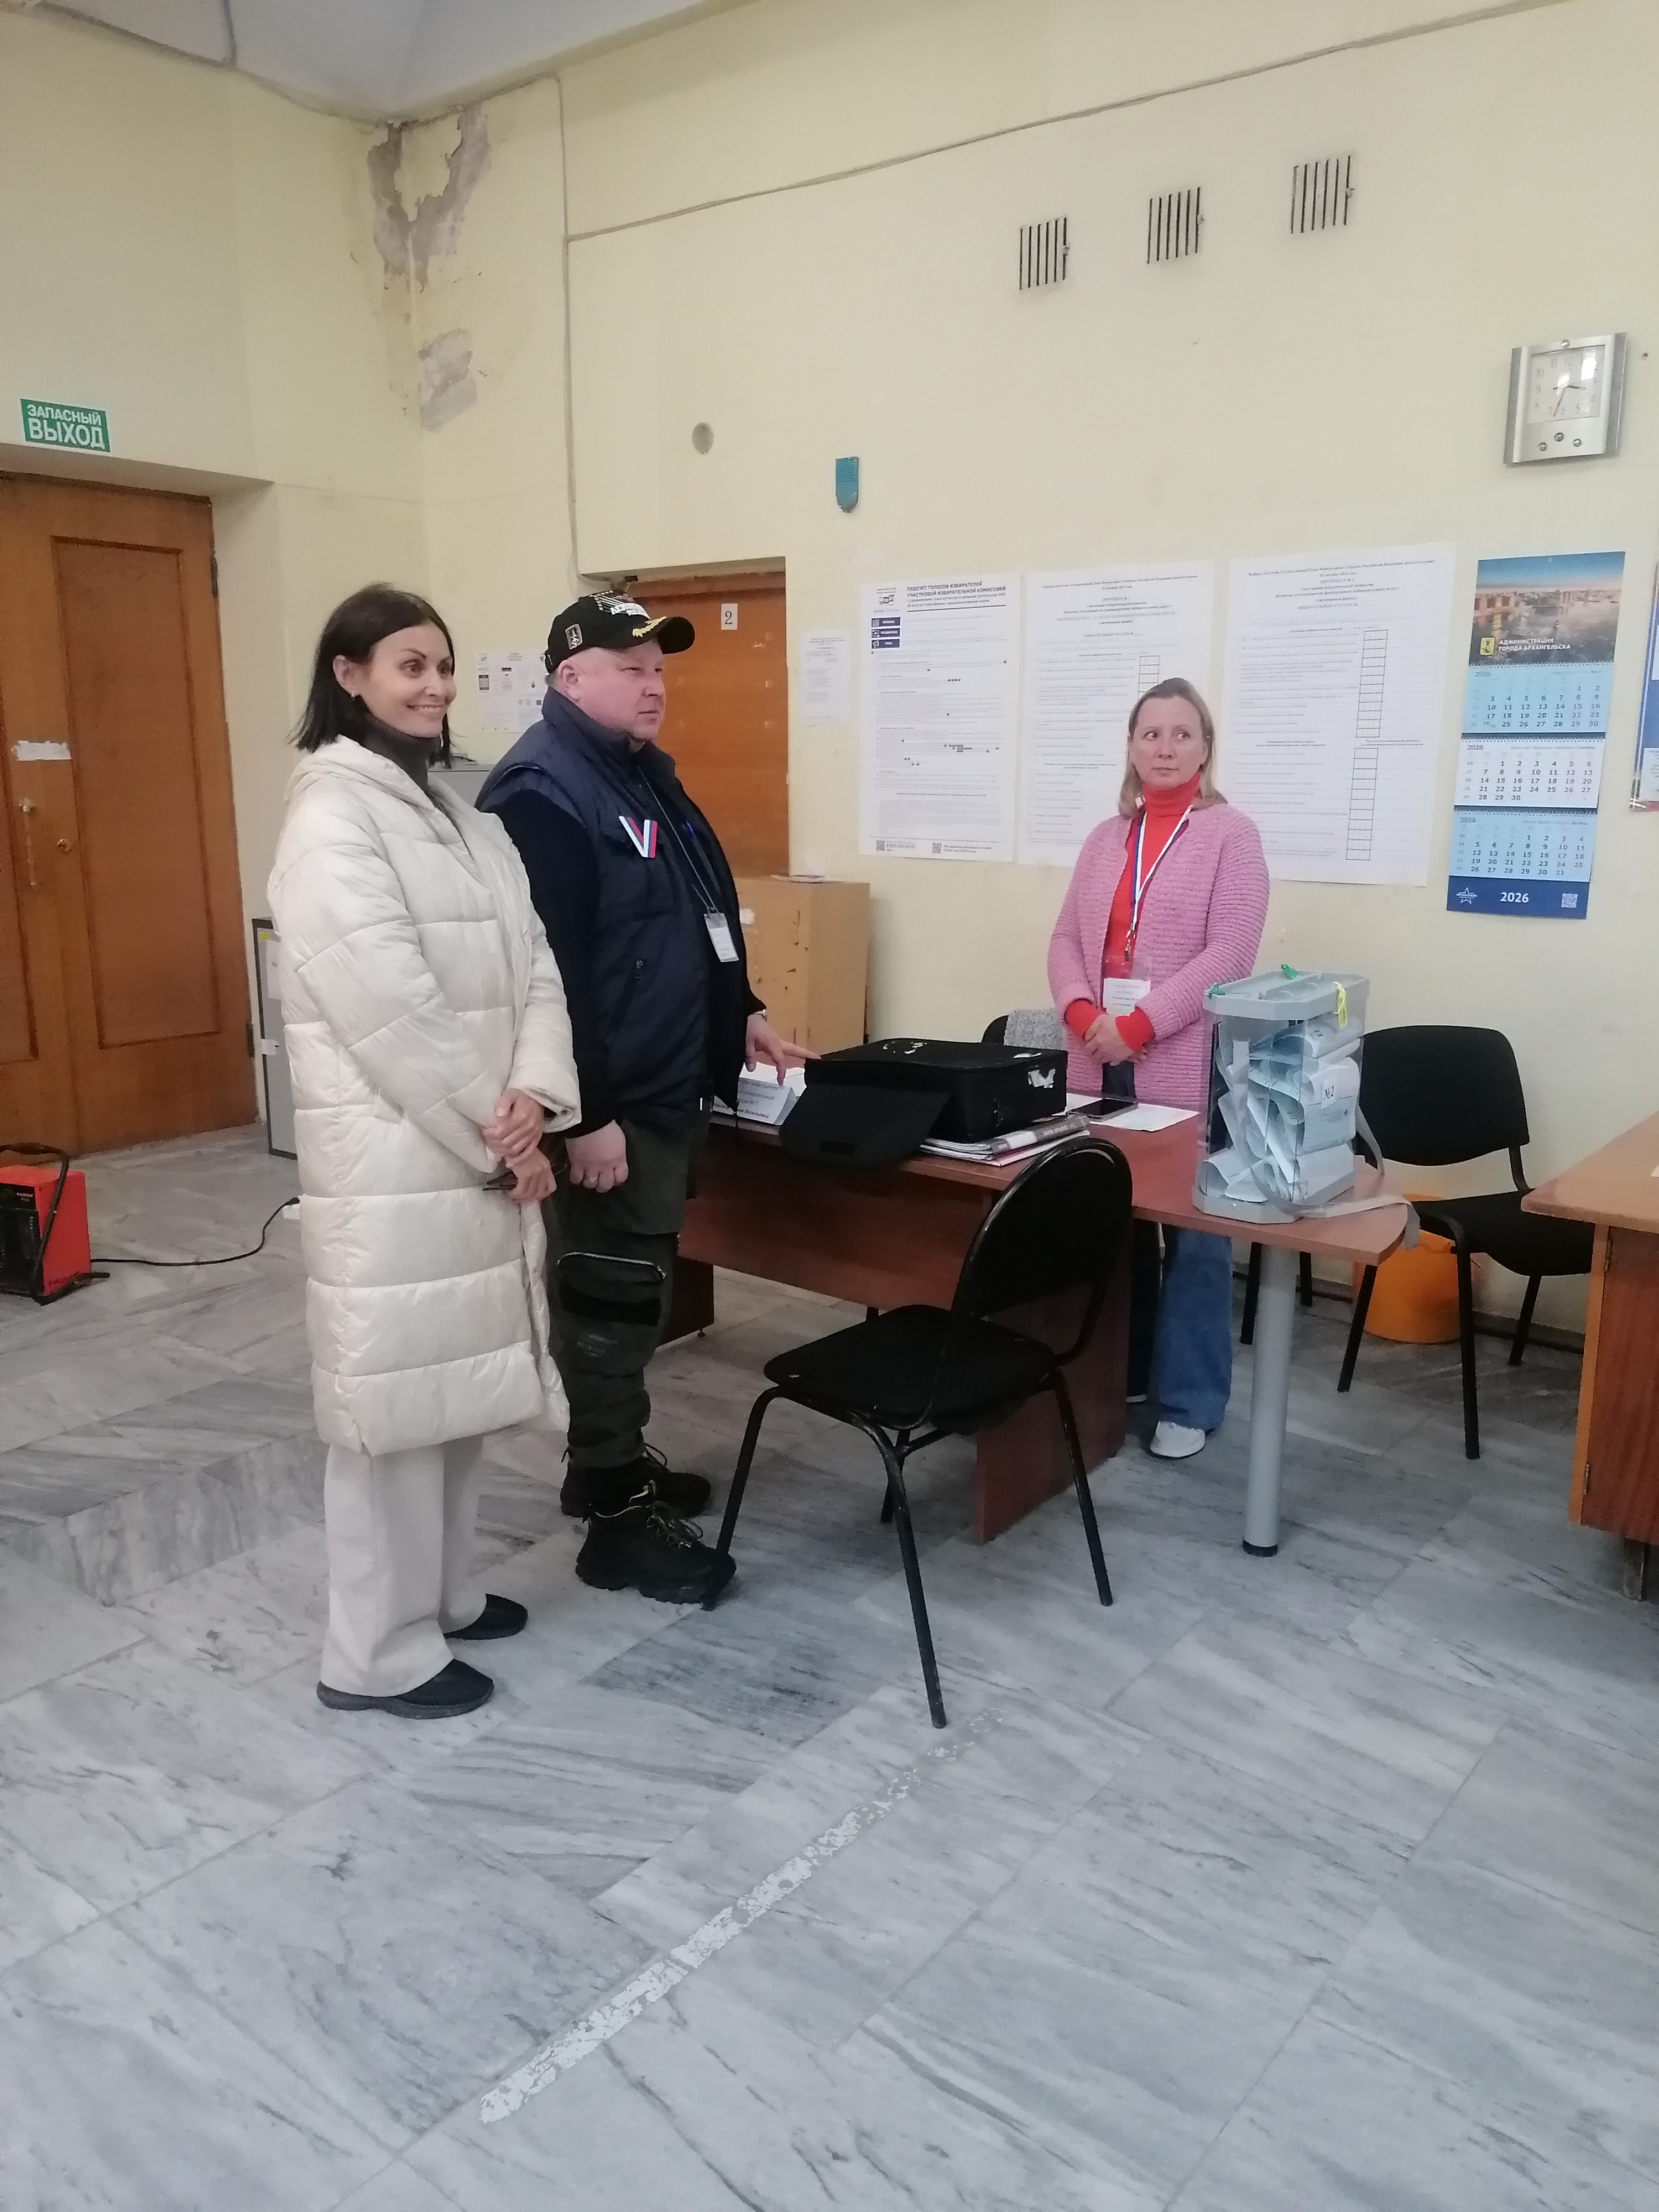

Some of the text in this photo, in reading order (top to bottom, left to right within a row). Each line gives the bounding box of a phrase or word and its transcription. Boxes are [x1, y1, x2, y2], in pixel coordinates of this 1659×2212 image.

[1536, 384, 1541, 394] 9
[28, 404, 102, 426] ЗАПАСНЫЙ
[28, 418, 106, 450] ВЫХОД
[724, 611, 733, 625] 2
[1500, 892, 1530, 903] 2026
